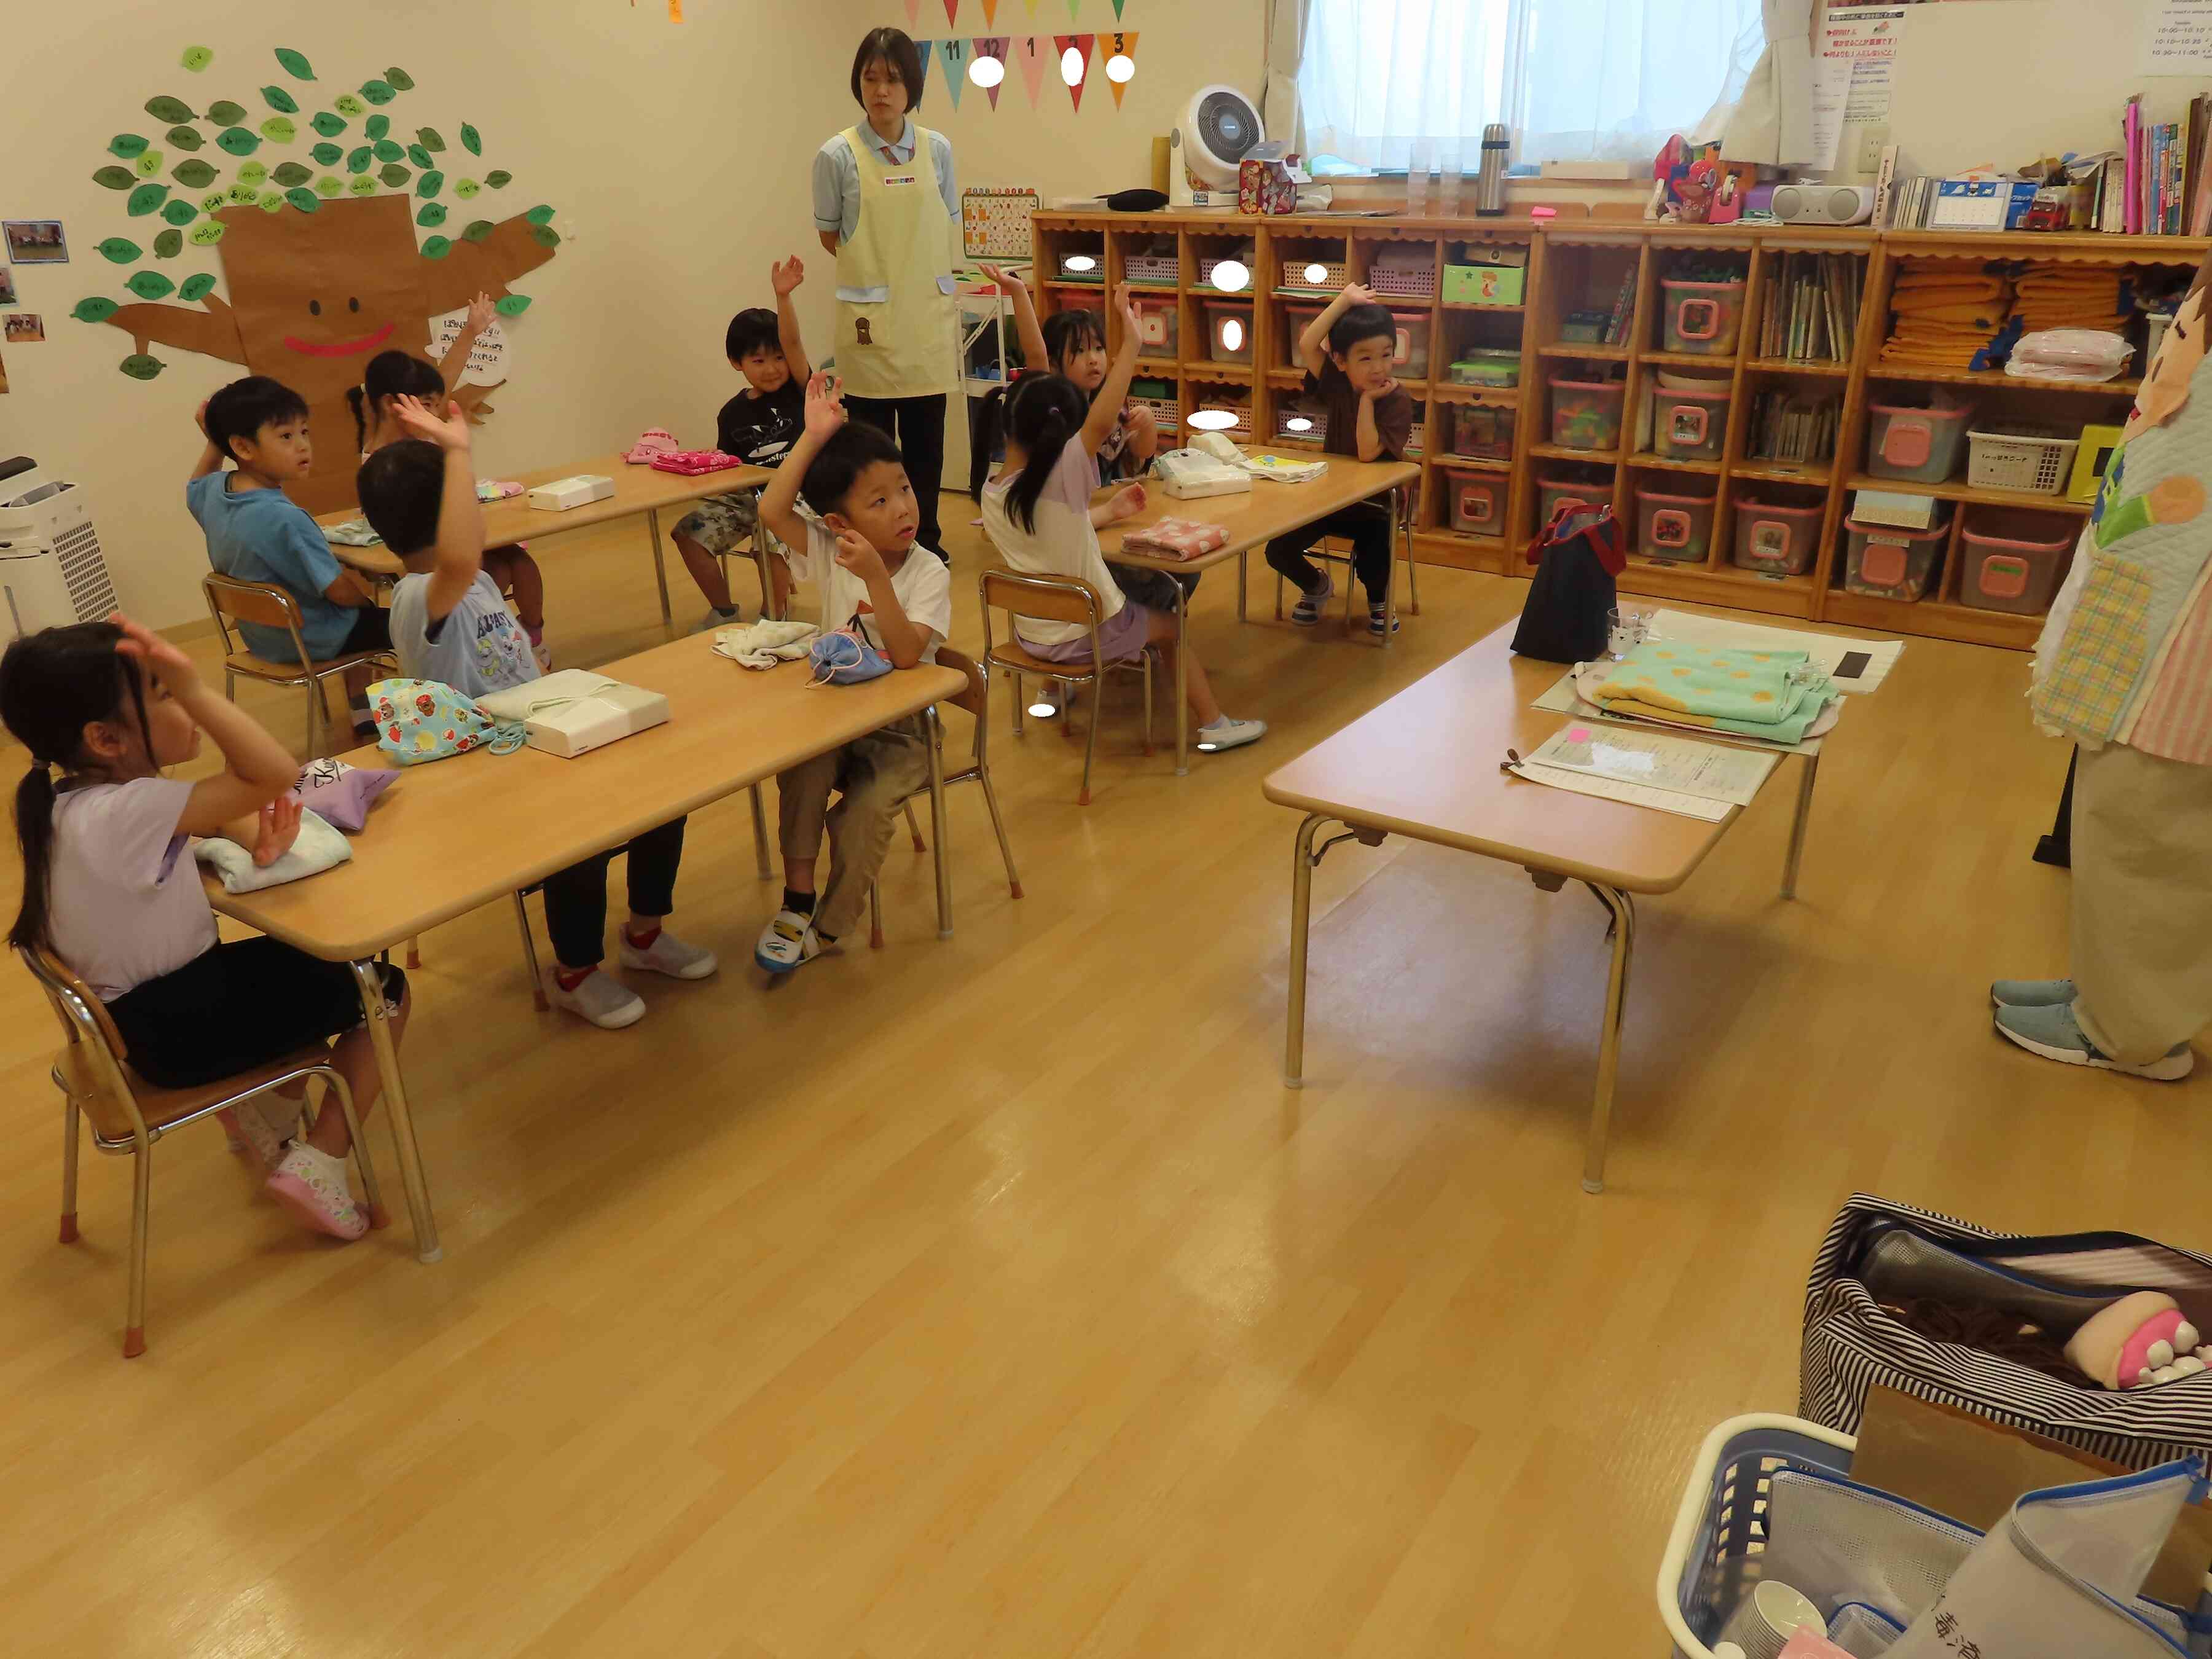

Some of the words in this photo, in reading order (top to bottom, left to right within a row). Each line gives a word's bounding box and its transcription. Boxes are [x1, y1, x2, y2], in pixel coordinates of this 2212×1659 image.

[946, 41, 960, 60] 11
[984, 39, 1000, 58] 12
[1027, 37, 1035, 57] 1
[1114, 33, 1124, 53] 3
